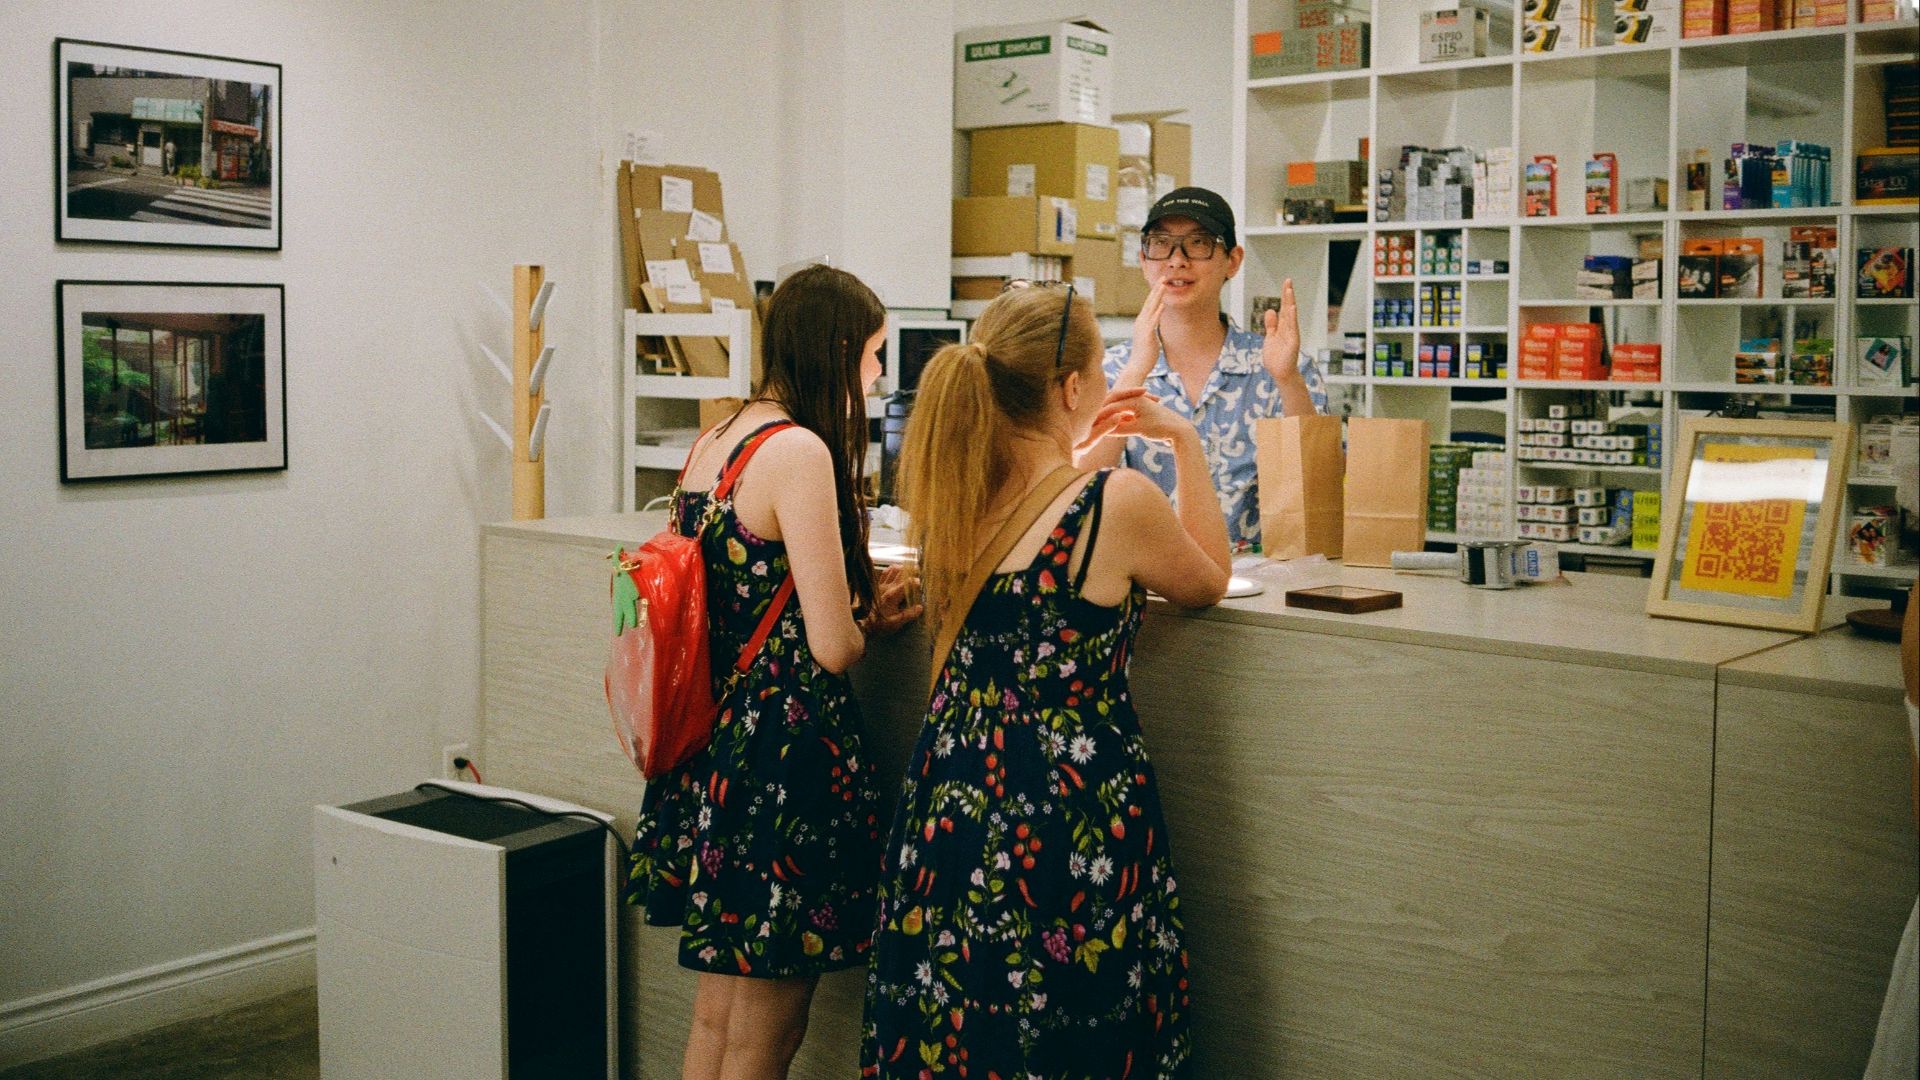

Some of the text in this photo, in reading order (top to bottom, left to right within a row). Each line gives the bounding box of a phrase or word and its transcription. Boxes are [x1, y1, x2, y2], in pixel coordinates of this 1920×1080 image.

[1431, 31, 1463, 42] ESPIO
[970, 43, 1000, 58] ULINE
[1438, 42, 1457, 55] 115
[1527, 549, 1539, 577] ULINE
